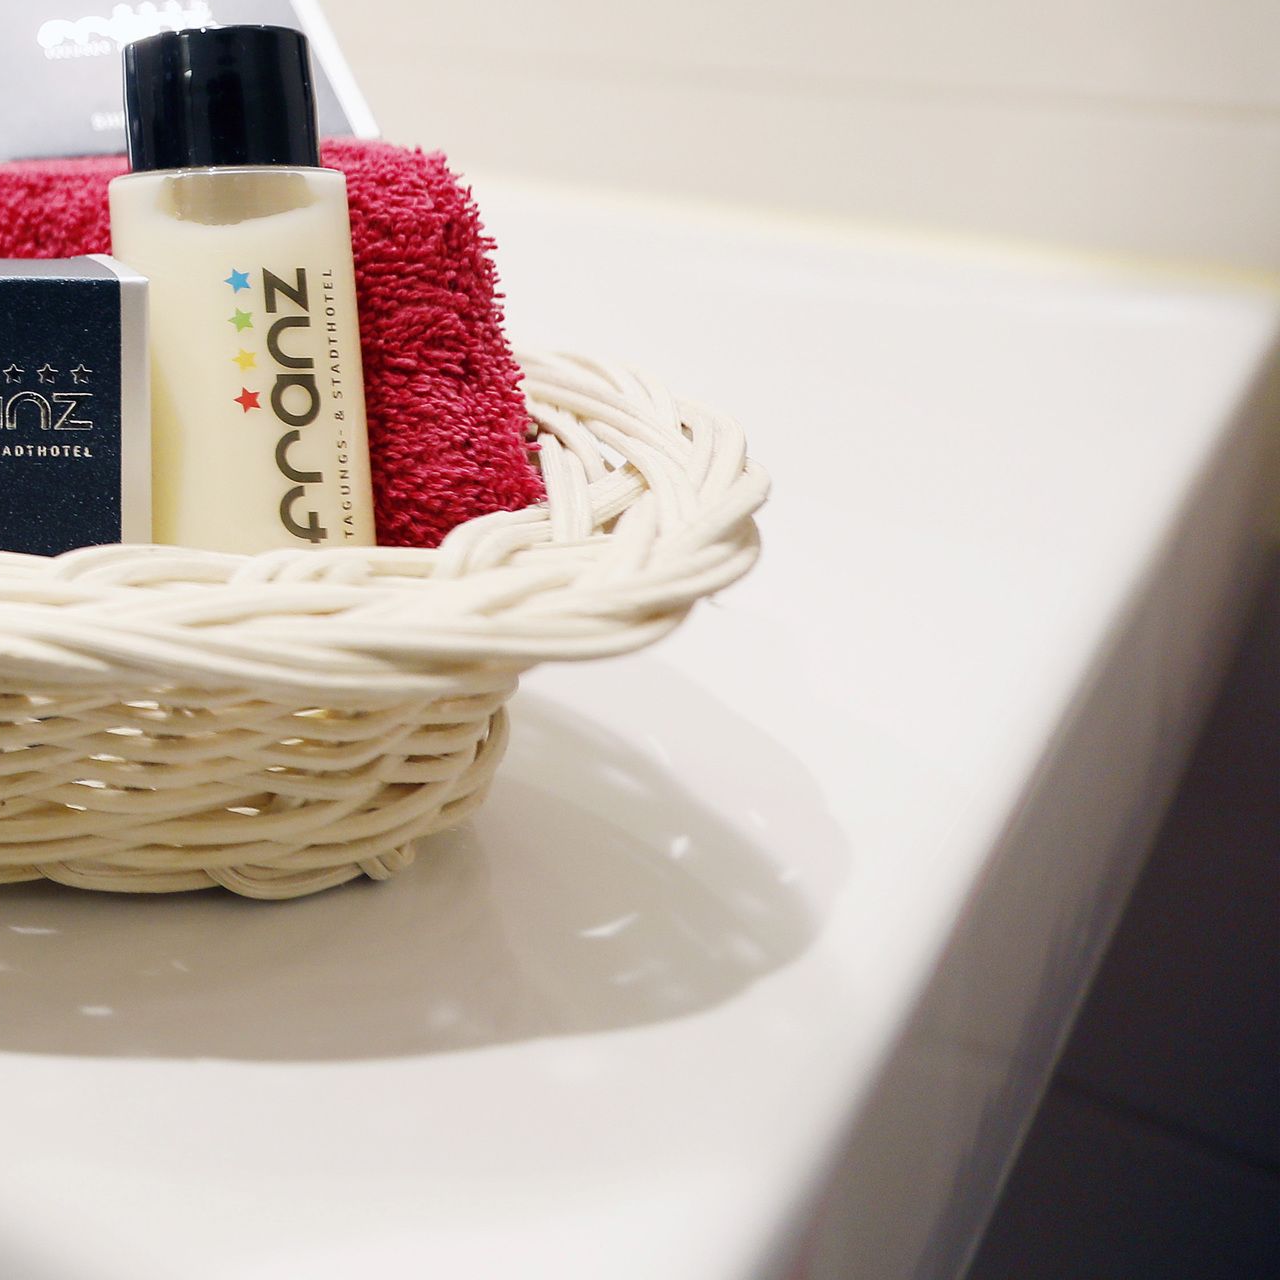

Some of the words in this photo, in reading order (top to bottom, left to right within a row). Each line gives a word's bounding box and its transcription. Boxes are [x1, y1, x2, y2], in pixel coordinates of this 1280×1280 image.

[322, 269, 343, 399] STADTHOTEL
[262, 268, 327, 543] franz
[335, 410, 344, 420] &
[337, 430, 354, 539] TAGUNGS-
